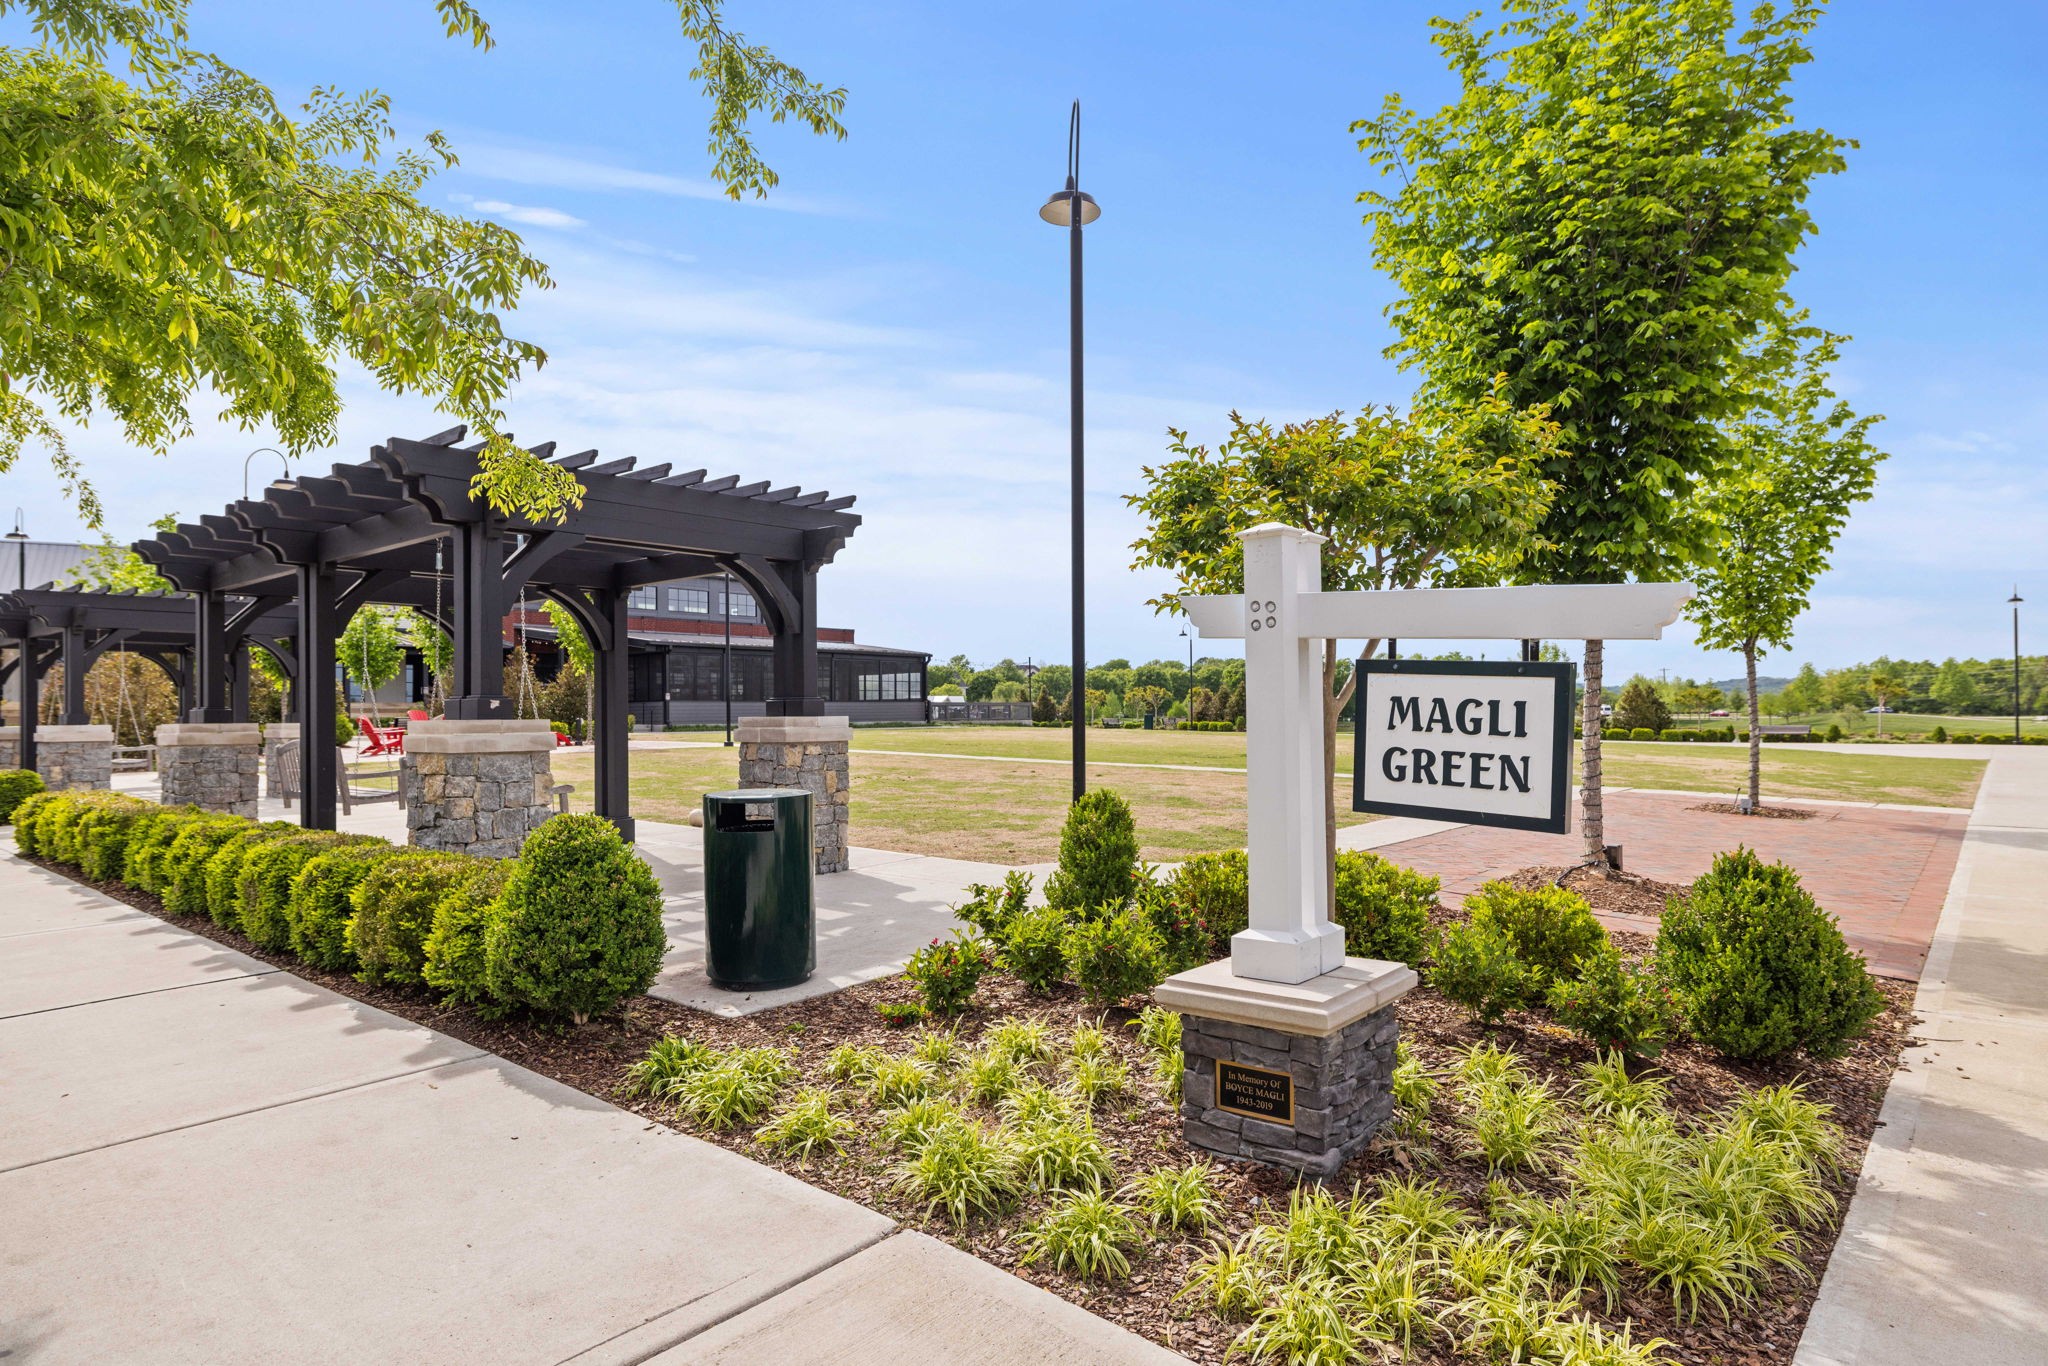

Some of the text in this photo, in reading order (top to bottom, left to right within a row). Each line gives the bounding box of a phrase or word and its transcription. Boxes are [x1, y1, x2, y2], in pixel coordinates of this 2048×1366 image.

[1387, 695, 1528, 738] MAGLI
[1382, 746, 1531, 793] GREEN
[1228, 1071, 1282, 1088] In Memory Of
[1225, 1081, 1285, 1102] BOYCE MAGLI
[1236, 1095, 1273, 1110] 1943-2019
